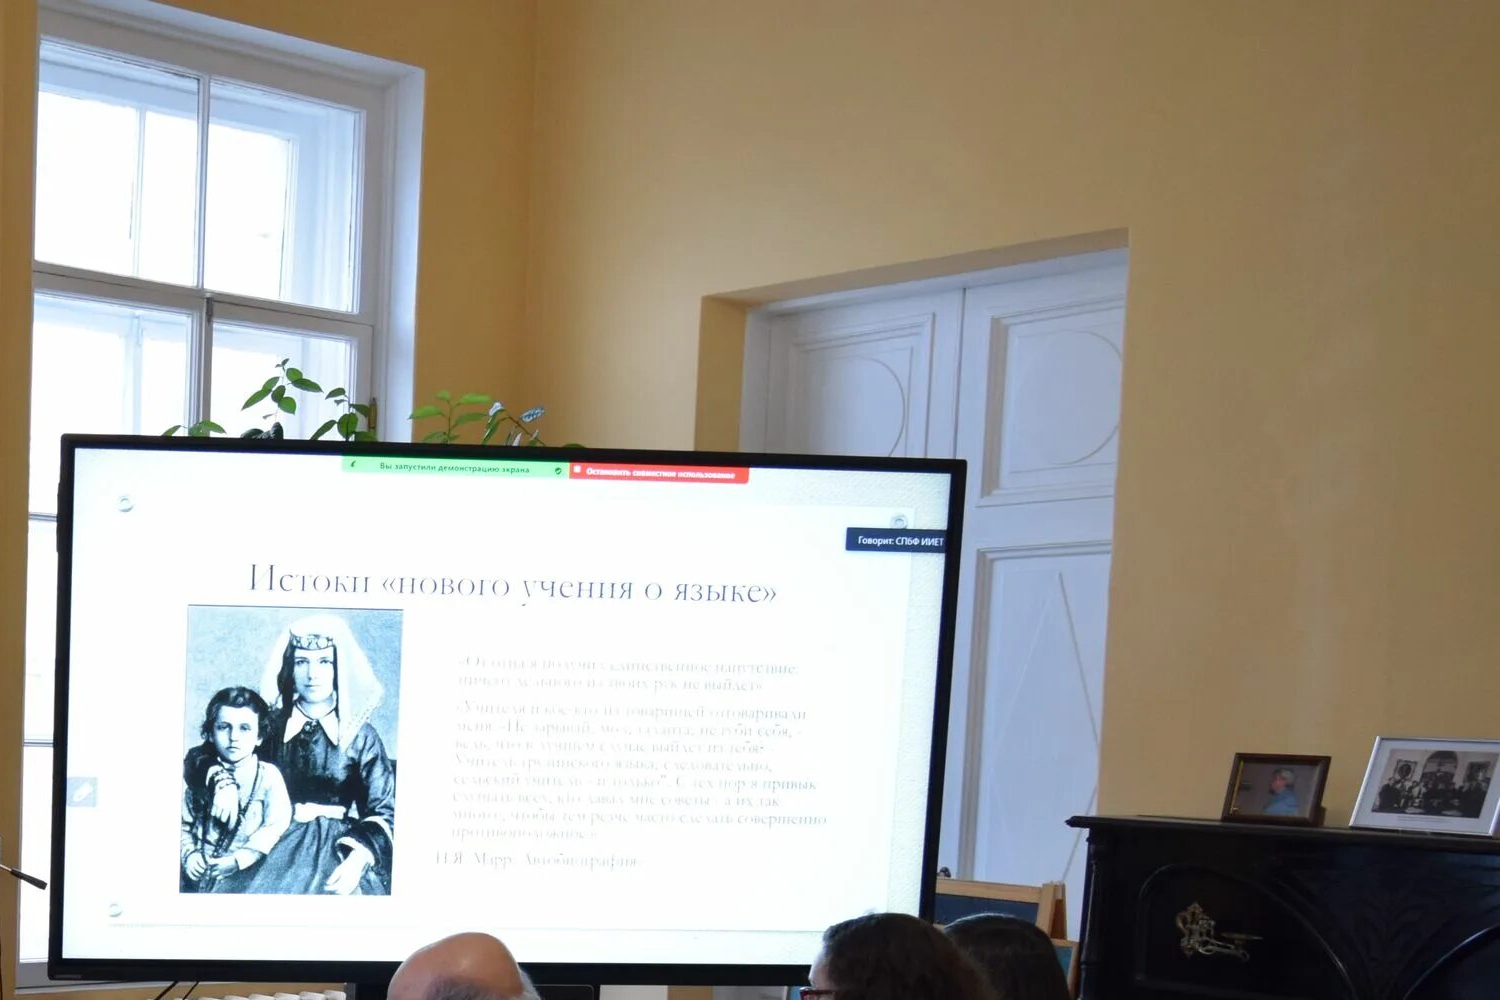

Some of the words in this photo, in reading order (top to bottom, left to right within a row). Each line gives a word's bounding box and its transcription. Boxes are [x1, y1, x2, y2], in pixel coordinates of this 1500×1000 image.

[380, 462, 392, 470] Вы
[395, 464, 436, 472] запустили
[438, 465, 500, 474] демонстрацию
[502, 467, 530, 475] экрана
[858, 535, 894, 547] Говорит:
[895, 536, 920, 547] СПбФ
[921, 537, 944, 547] ИИЕТ
[250, 563, 371, 593] Истоки
[382, 575, 510, 597] «нового
[521, 580, 633, 607] учения
[644, 582, 663, 601] о
[675, 583, 777, 604] языке»
